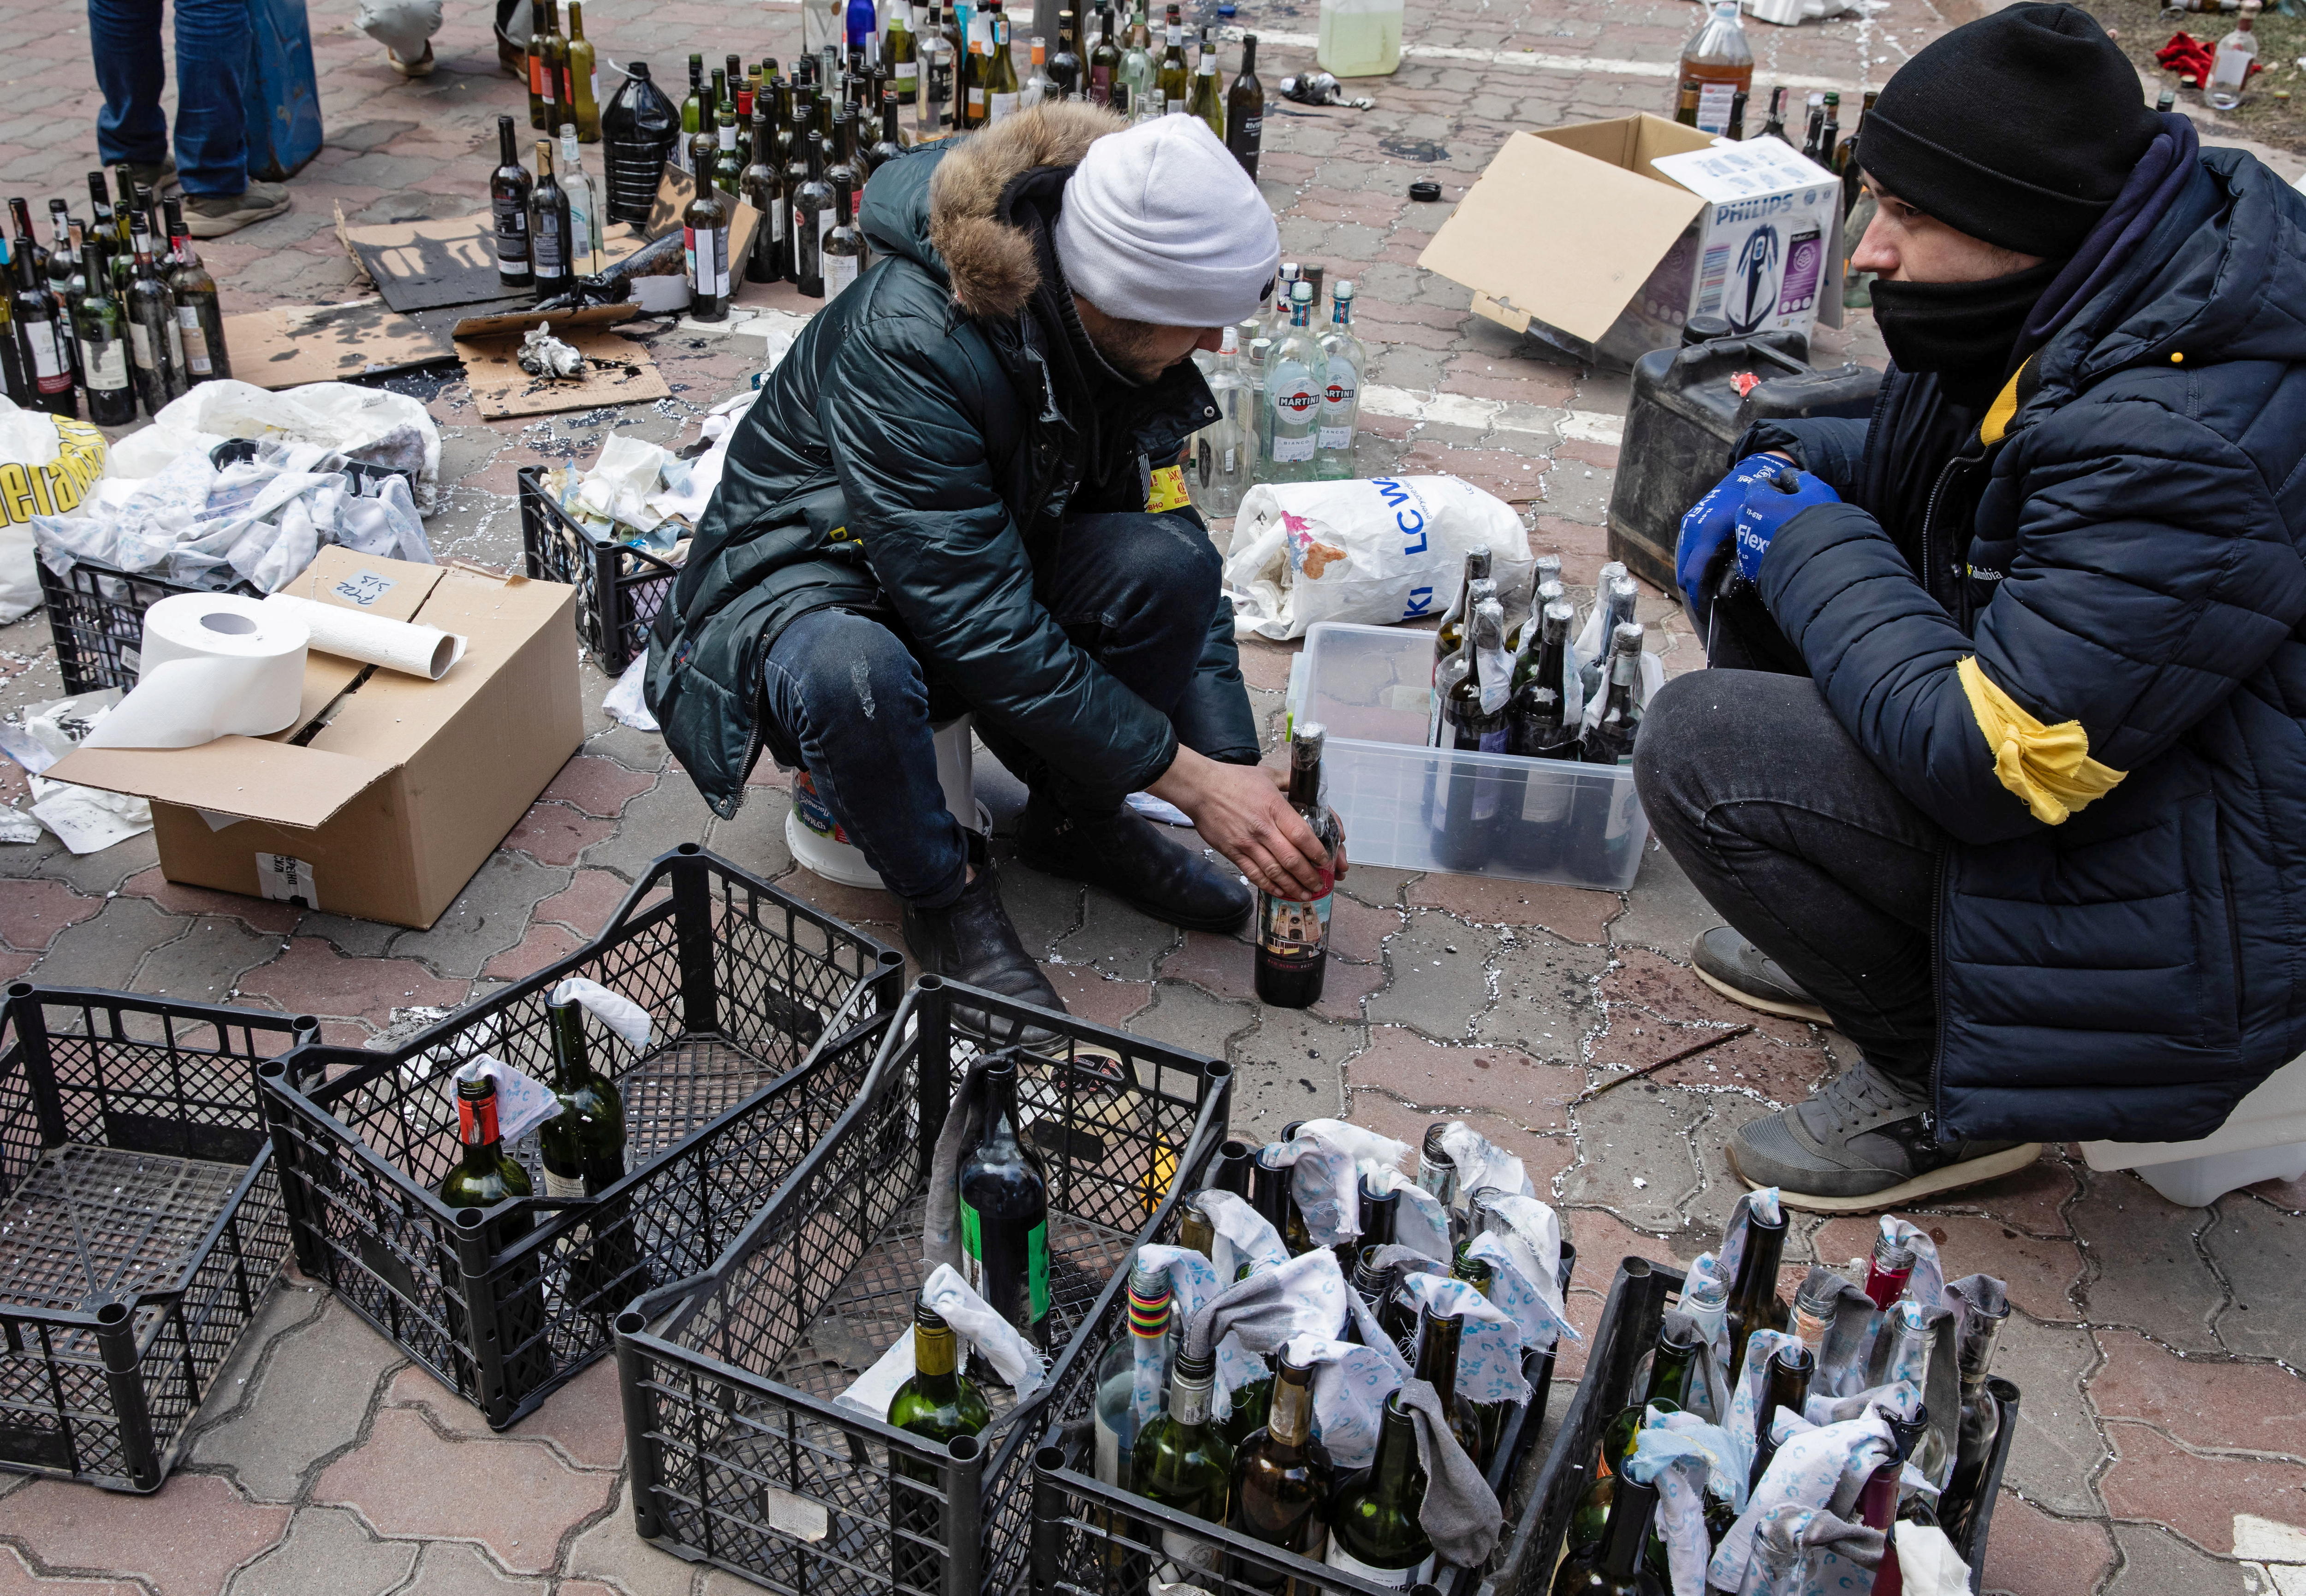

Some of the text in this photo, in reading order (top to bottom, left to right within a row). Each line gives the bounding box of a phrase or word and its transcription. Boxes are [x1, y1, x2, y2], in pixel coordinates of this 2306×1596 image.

[1716, 193, 1793, 225] PHILIPS
[1280, 395, 1319, 406] MARTINI
[1412, 489, 1432, 520] everyone
[1746, 508, 1763, 521] 11-618
[1397, 509, 1427, 555] LC
[1402, 586, 1433, 621] KI
[802, 811, 826, 830] ЧУМАК
